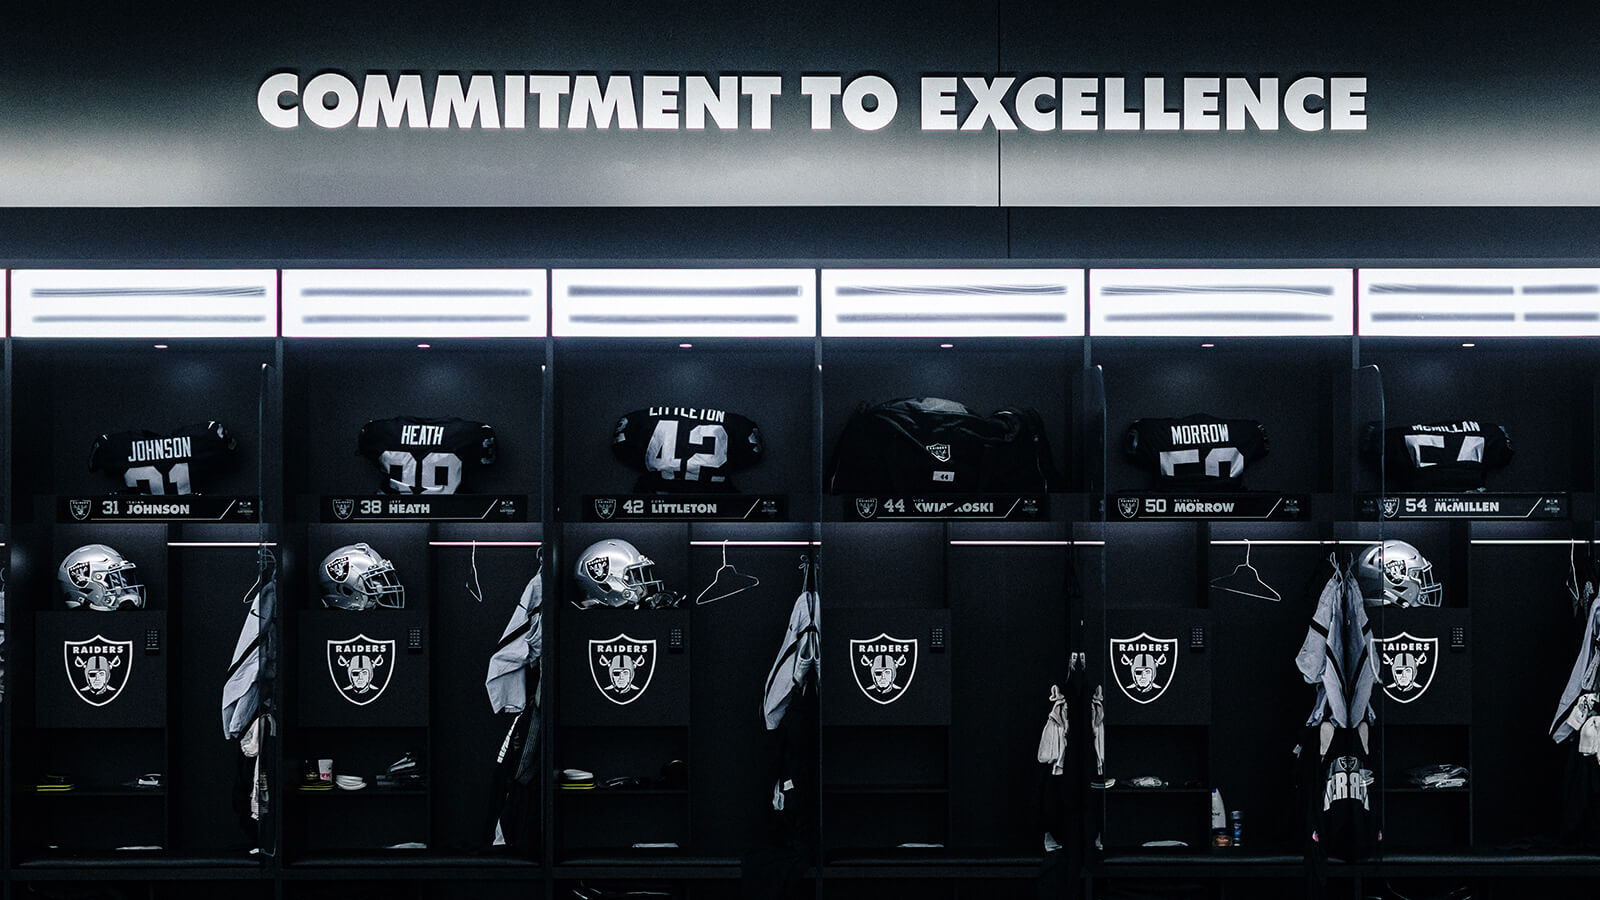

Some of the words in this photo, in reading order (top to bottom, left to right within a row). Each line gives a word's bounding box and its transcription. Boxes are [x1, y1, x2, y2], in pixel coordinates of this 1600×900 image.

[257, 73, 782, 130] COMMITMENT
[801, 75, 898, 131] TO
[920, 76, 1368, 132] EXCELLENCE
[400, 425, 445, 446] HEATH
[1171, 423, 1230, 446] MORROW
[128, 436, 192, 462] JOHNSON
[645, 419, 729, 482] 42
[102, 501, 120, 515] 31
[126, 505, 190, 515] JOHNSON
[360, 500, 382, 514] 38
[388, 504, 430, 514] HEATH
[622, 500, 644, 514] 42
[651, 504, 717, 514] LITTLETON
[883, 499, 905, 513] 44
[1145, 499, 1167, 513] 50
[1174, 503, 1235, 513] MORROW
[1405, 498, 1428, 513] 54
[1434, 502, 1500, 512] McMILLEN
[72, 645, 124, 654] RAIDERS
[335, 645, 387, 653] RAIDERS
[597, 644, 648, 653] RAIDERS
[858, 644, 909, 653] RAIDERS
[1118, 643, 1169, 652] RAIDERS
